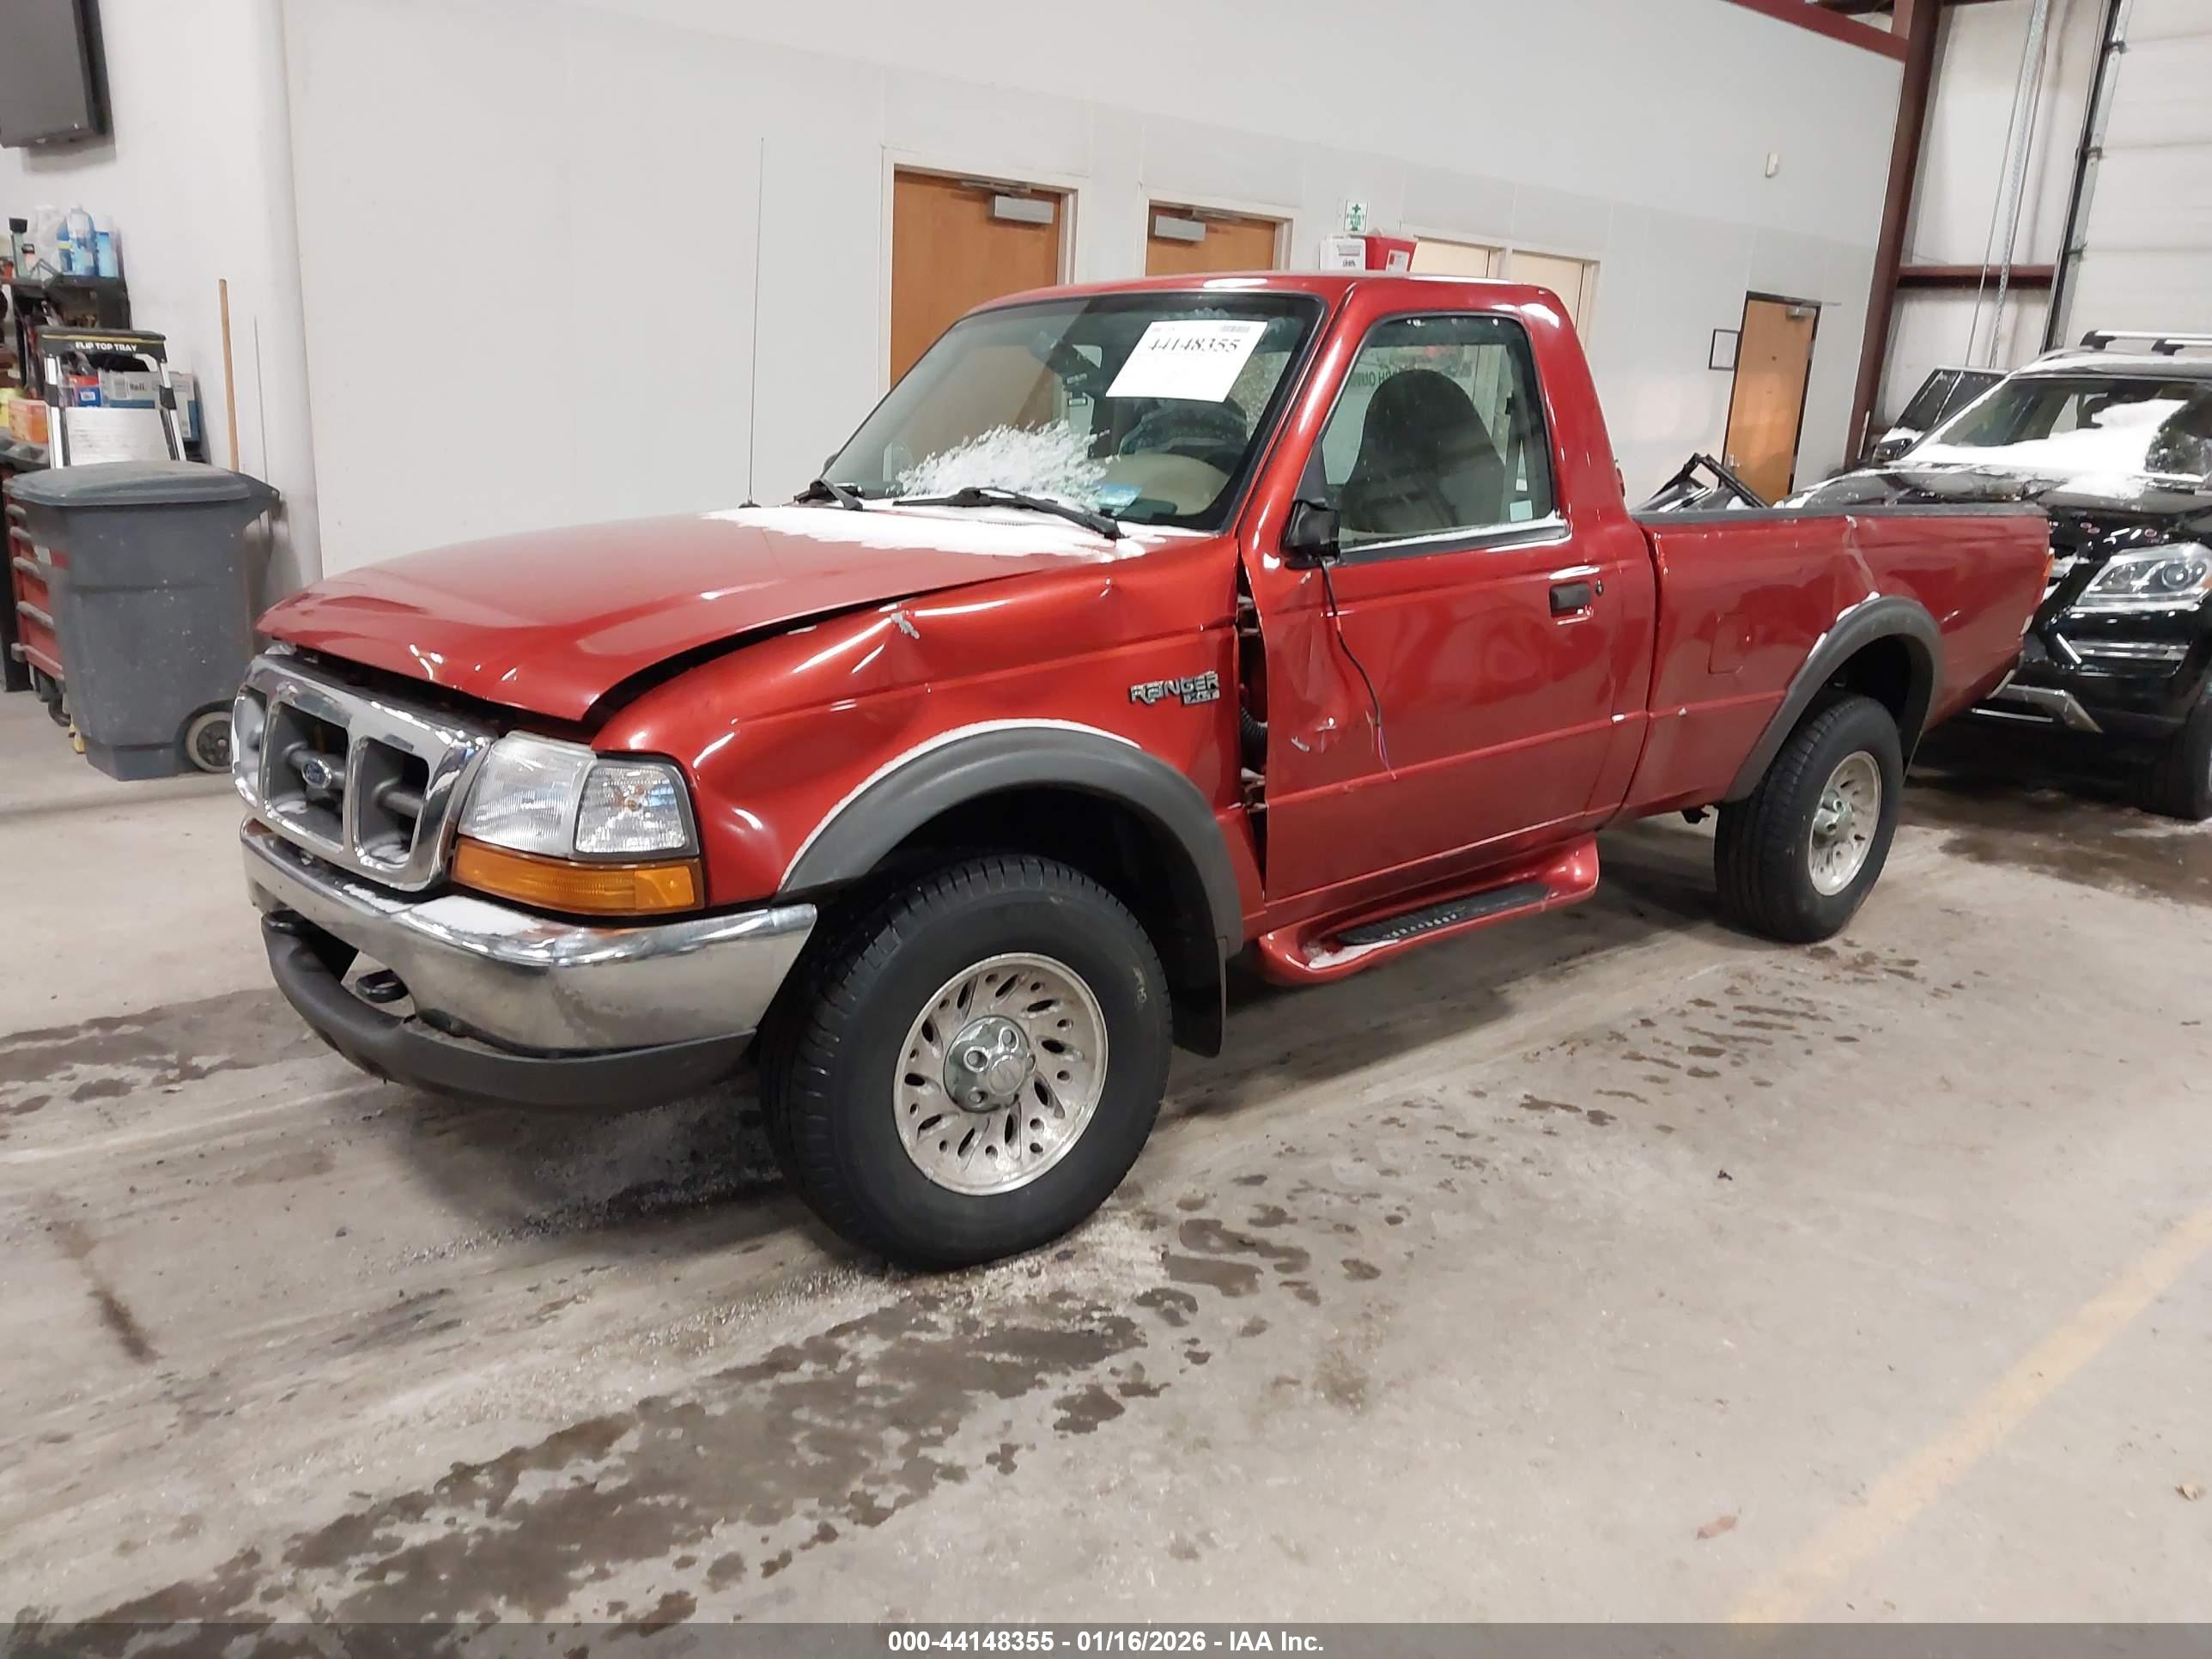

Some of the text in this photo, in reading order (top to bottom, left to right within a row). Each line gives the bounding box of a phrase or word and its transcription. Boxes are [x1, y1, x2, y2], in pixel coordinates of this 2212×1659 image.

[75, 341, 137, 352] FLIP TOP TRAY
[1147, 337, 1242, 353] 44148355
[1129, 670, 1220, 704] RANGER
